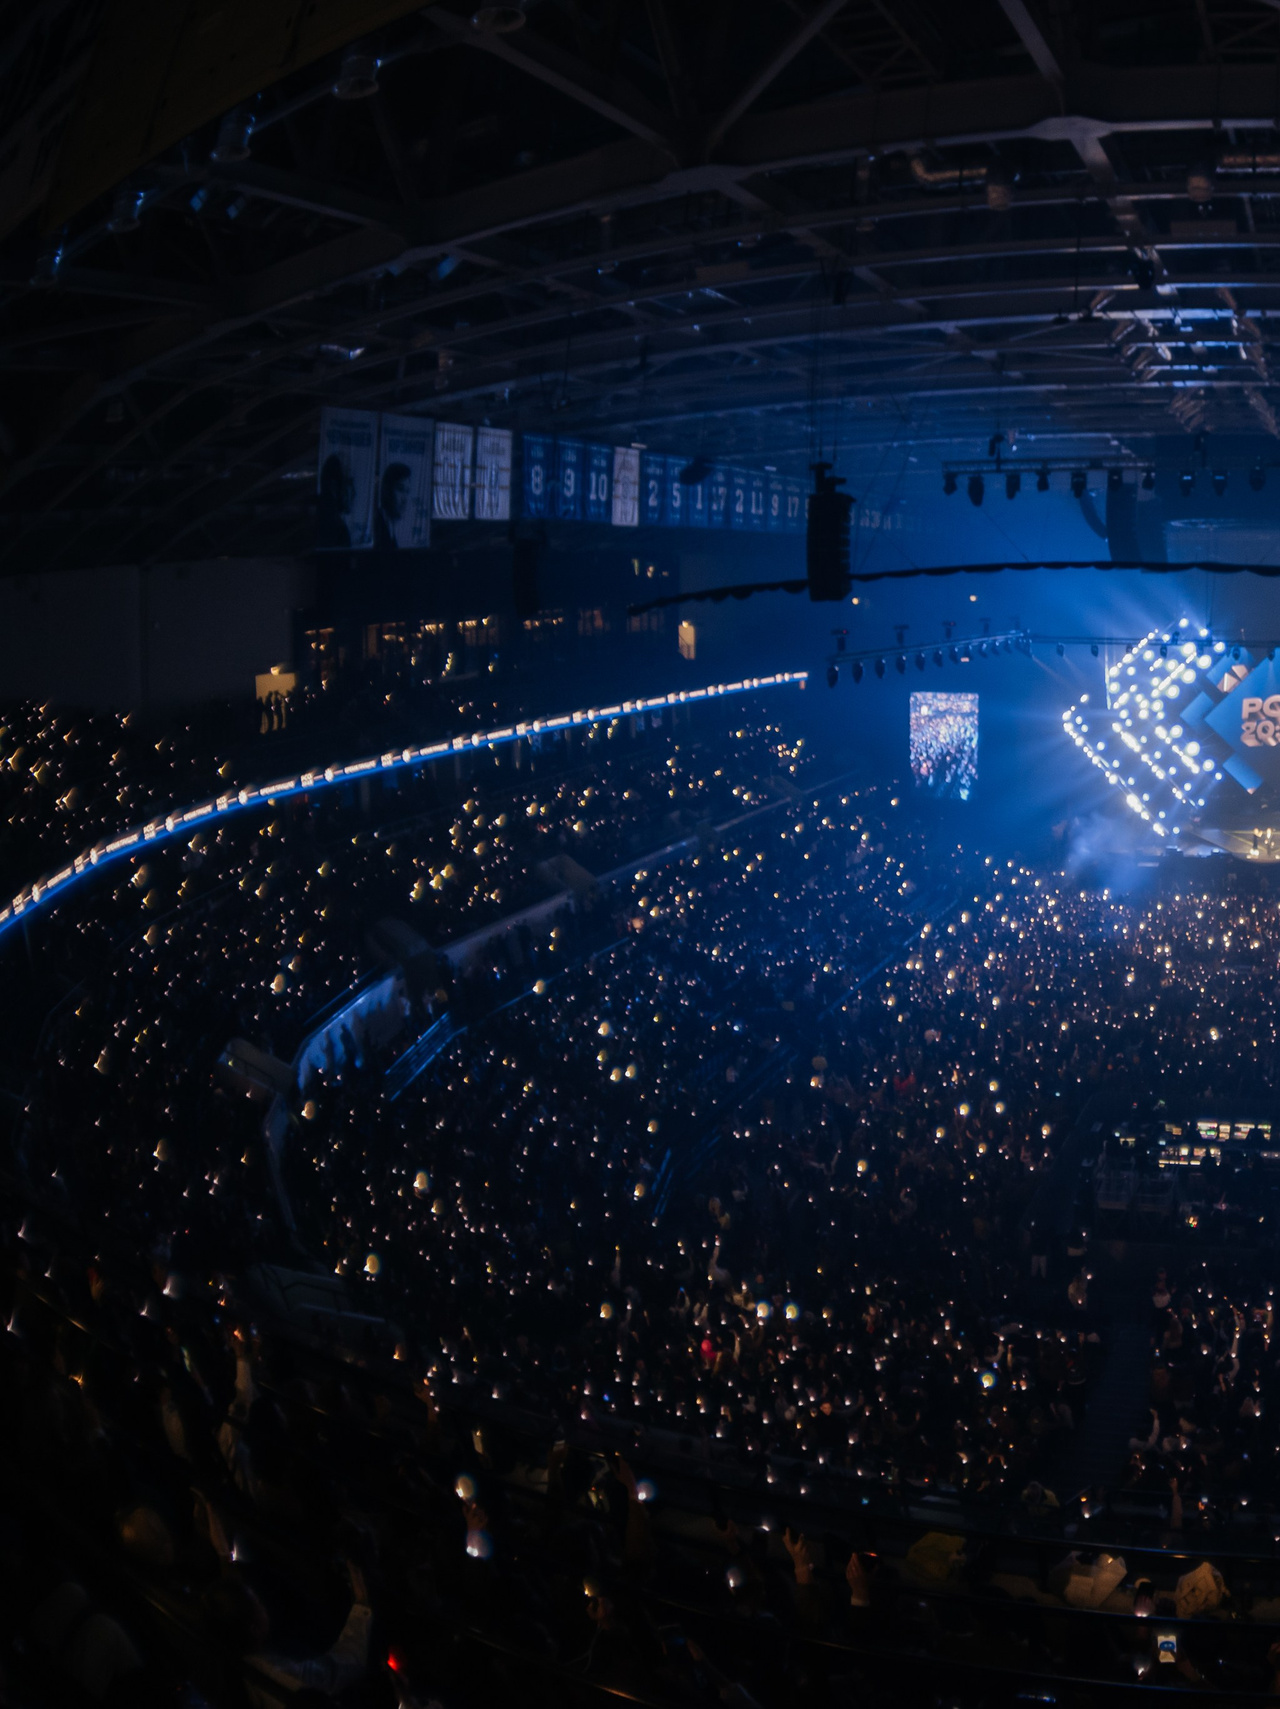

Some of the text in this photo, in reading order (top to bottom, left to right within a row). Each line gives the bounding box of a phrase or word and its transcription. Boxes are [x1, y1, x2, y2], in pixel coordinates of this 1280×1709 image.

[531, 464, 544, 495] 8
[563, 468, 576, 497] 9
[589, 471, 608, 502] 10
[648, 479, 659, 507] 2
[672, 482, 681, 508] 5
